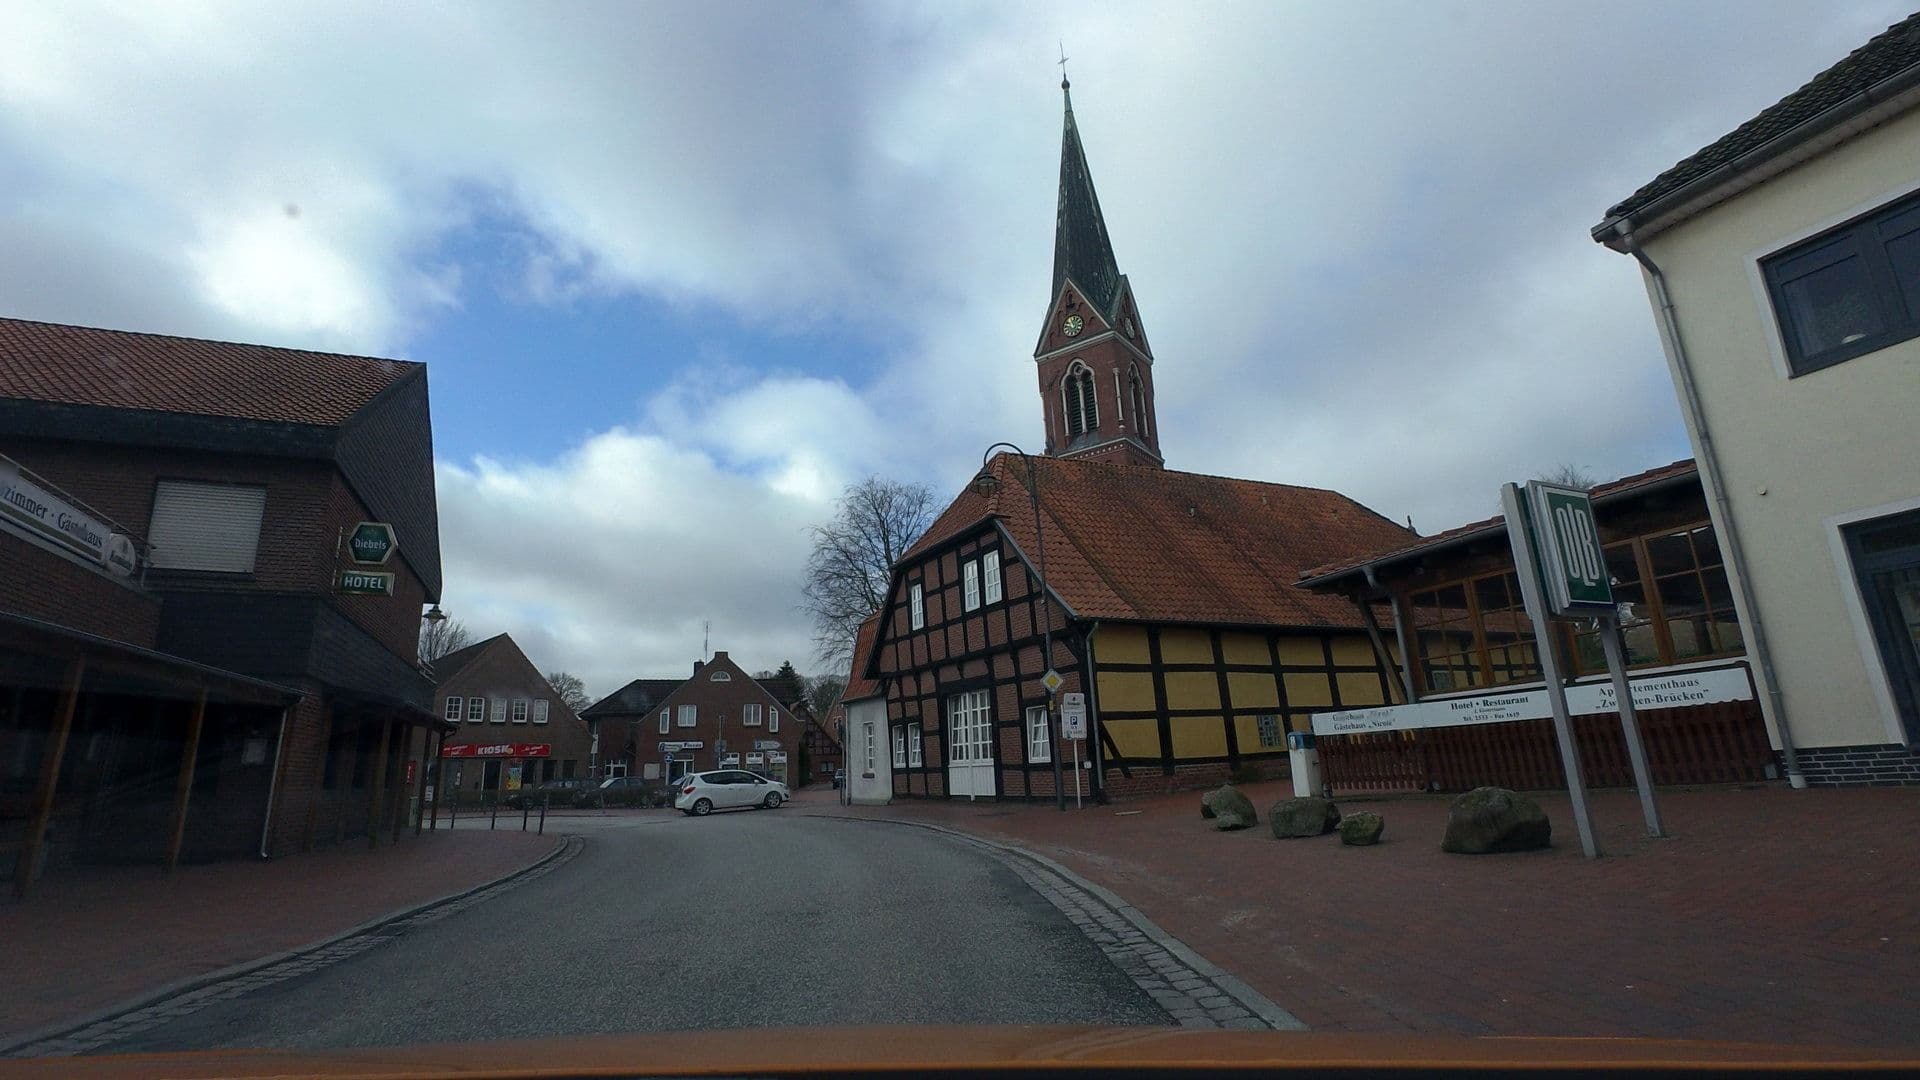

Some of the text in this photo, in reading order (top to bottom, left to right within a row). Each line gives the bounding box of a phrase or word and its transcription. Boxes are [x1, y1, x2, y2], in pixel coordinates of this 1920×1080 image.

[0, 485, 103, 546] zimmer Gäsaus
[355, 538, 387, 550] Diebels
[1556, 502, 1600, 587] OLB
[344, 576, 385, 589] HOTEL
[1599, 678, 1700, 698] Aptementhaus
[1451, 702, 1473, 710] Hotel
[1483, 696, 1529, 707] Restaurant
[1334, 722, 1367, 731] Gästehaus
[478, 744, 510, 755] KIOSK
